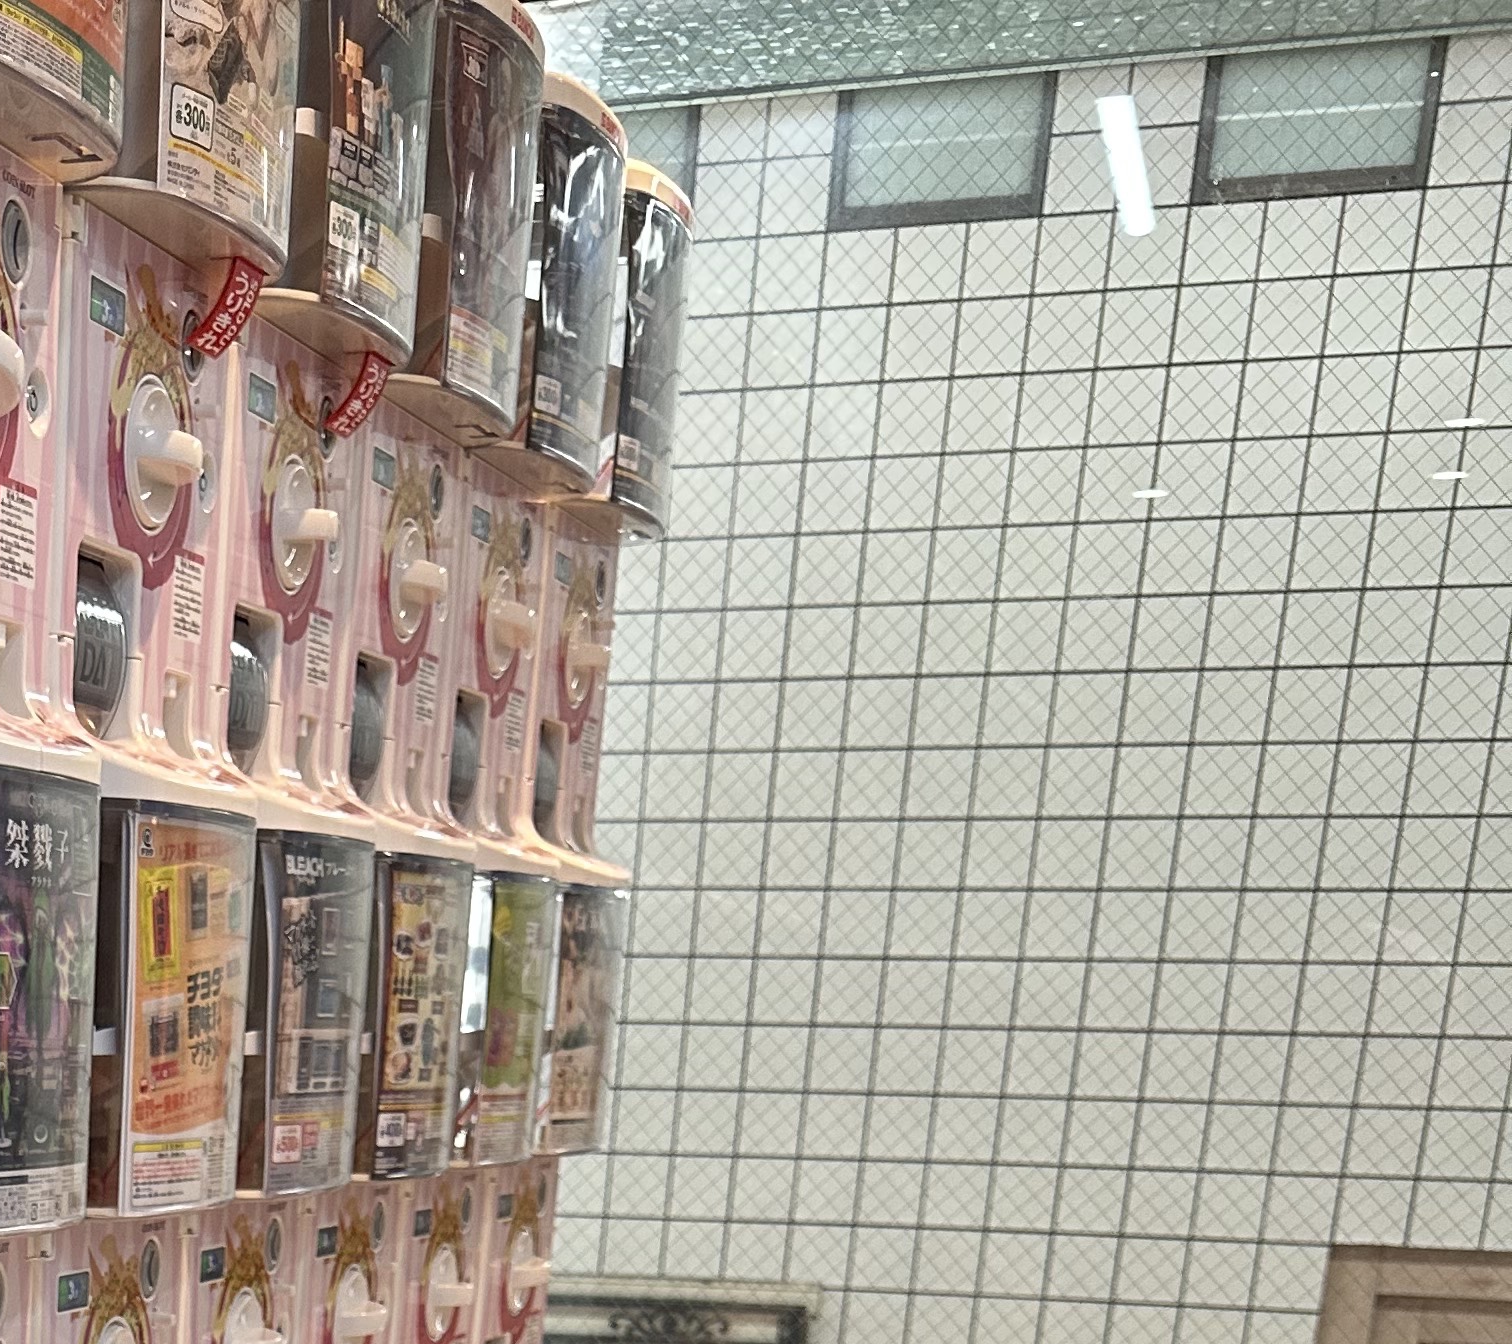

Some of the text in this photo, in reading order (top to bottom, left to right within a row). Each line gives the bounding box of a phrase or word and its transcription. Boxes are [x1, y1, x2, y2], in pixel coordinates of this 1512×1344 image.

[198, 271, 249, 349] うりきれ
[286, 854, 324, 878] BLEACH
